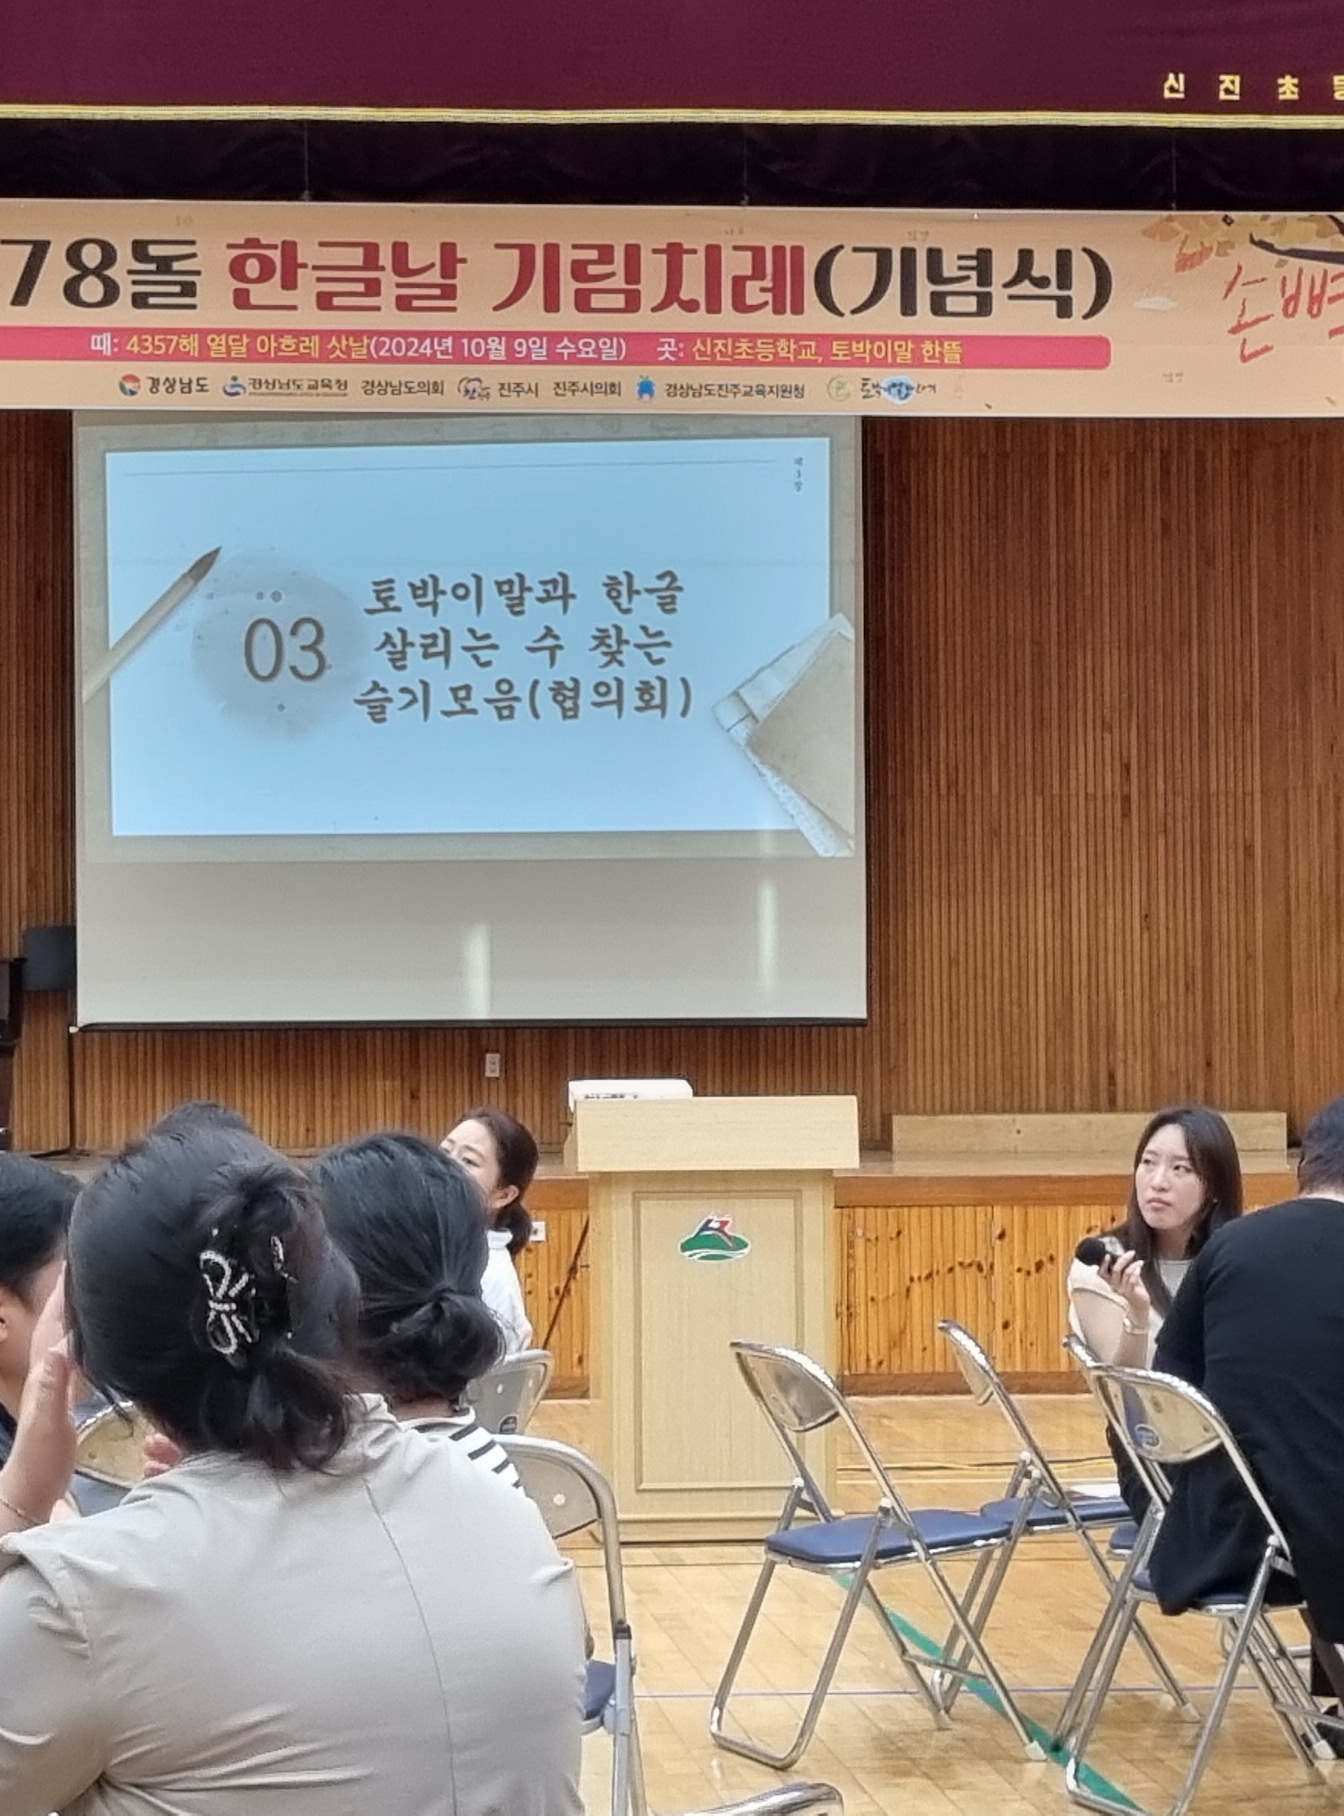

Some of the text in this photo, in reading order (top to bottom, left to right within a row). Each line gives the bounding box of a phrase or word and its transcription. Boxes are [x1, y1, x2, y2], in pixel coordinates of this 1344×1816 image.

[225, 237, 468, 312] 한글날
[492, 240, 1113, 320] 기림치레(기념식)
[90, 332, 963, 364] 때: 4357해 열달 아흐레 삿날(2024년 10월 9일 수요일) 곳: 신진초등학교, 토박이말 한뜰
[146, 375, 210, 395] 경상남도
[360, 379, 446, 396] 경상남도의회
[497, 381, 540, 398] 진주시
[552, 380, 623, 397] 진주시의회
[664, 382, 806, 400] 경상남도진주교육지원청
[363, 570, 685, 617] 토박이말과 한글
[244, 616, 328, 682] 03
[374, 622, 673, 671] 살리는 수 찾는
[353, 675, 693, 723] 슬기모음(협의회)
